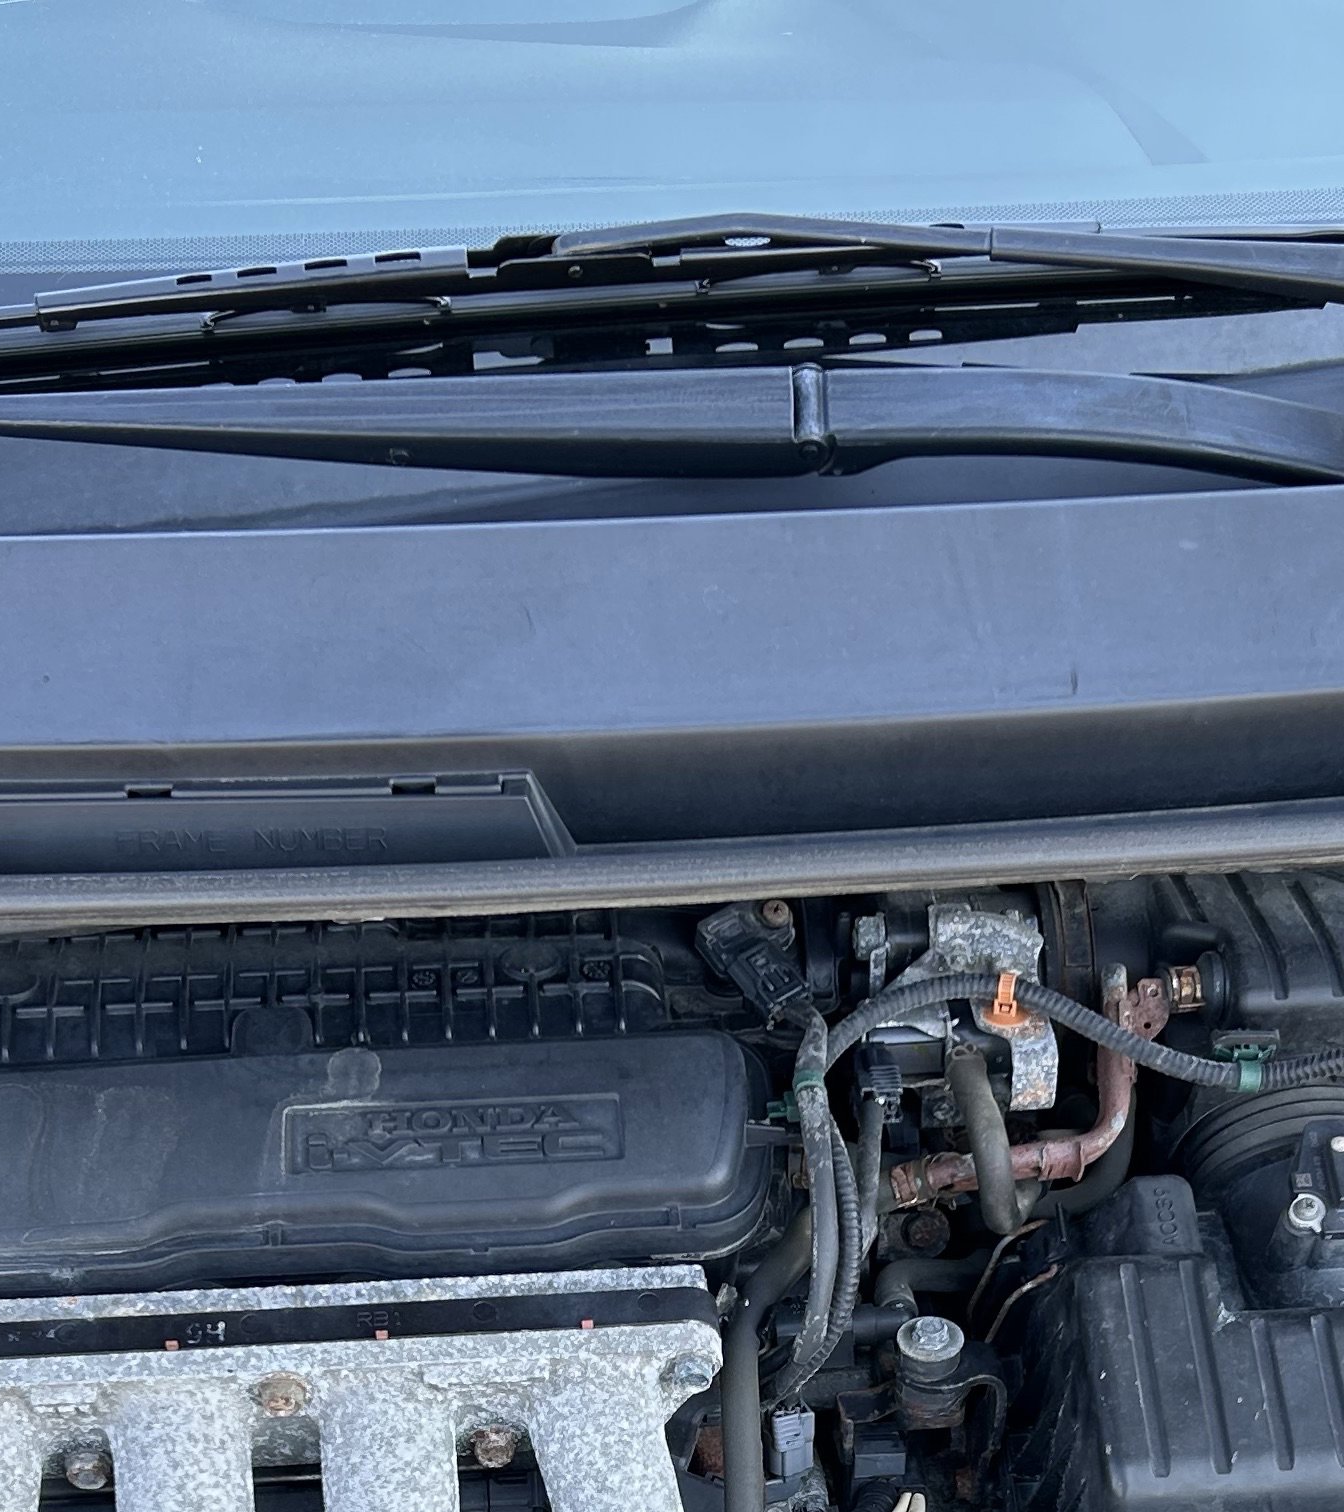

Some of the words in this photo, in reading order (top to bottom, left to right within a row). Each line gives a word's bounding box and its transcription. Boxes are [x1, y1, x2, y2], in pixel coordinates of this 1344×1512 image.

[115, 829, 226, 853] FRAME
[253, 825, 388, 852] NUMBER
[367, 1105, 580, 1138] HONDA
